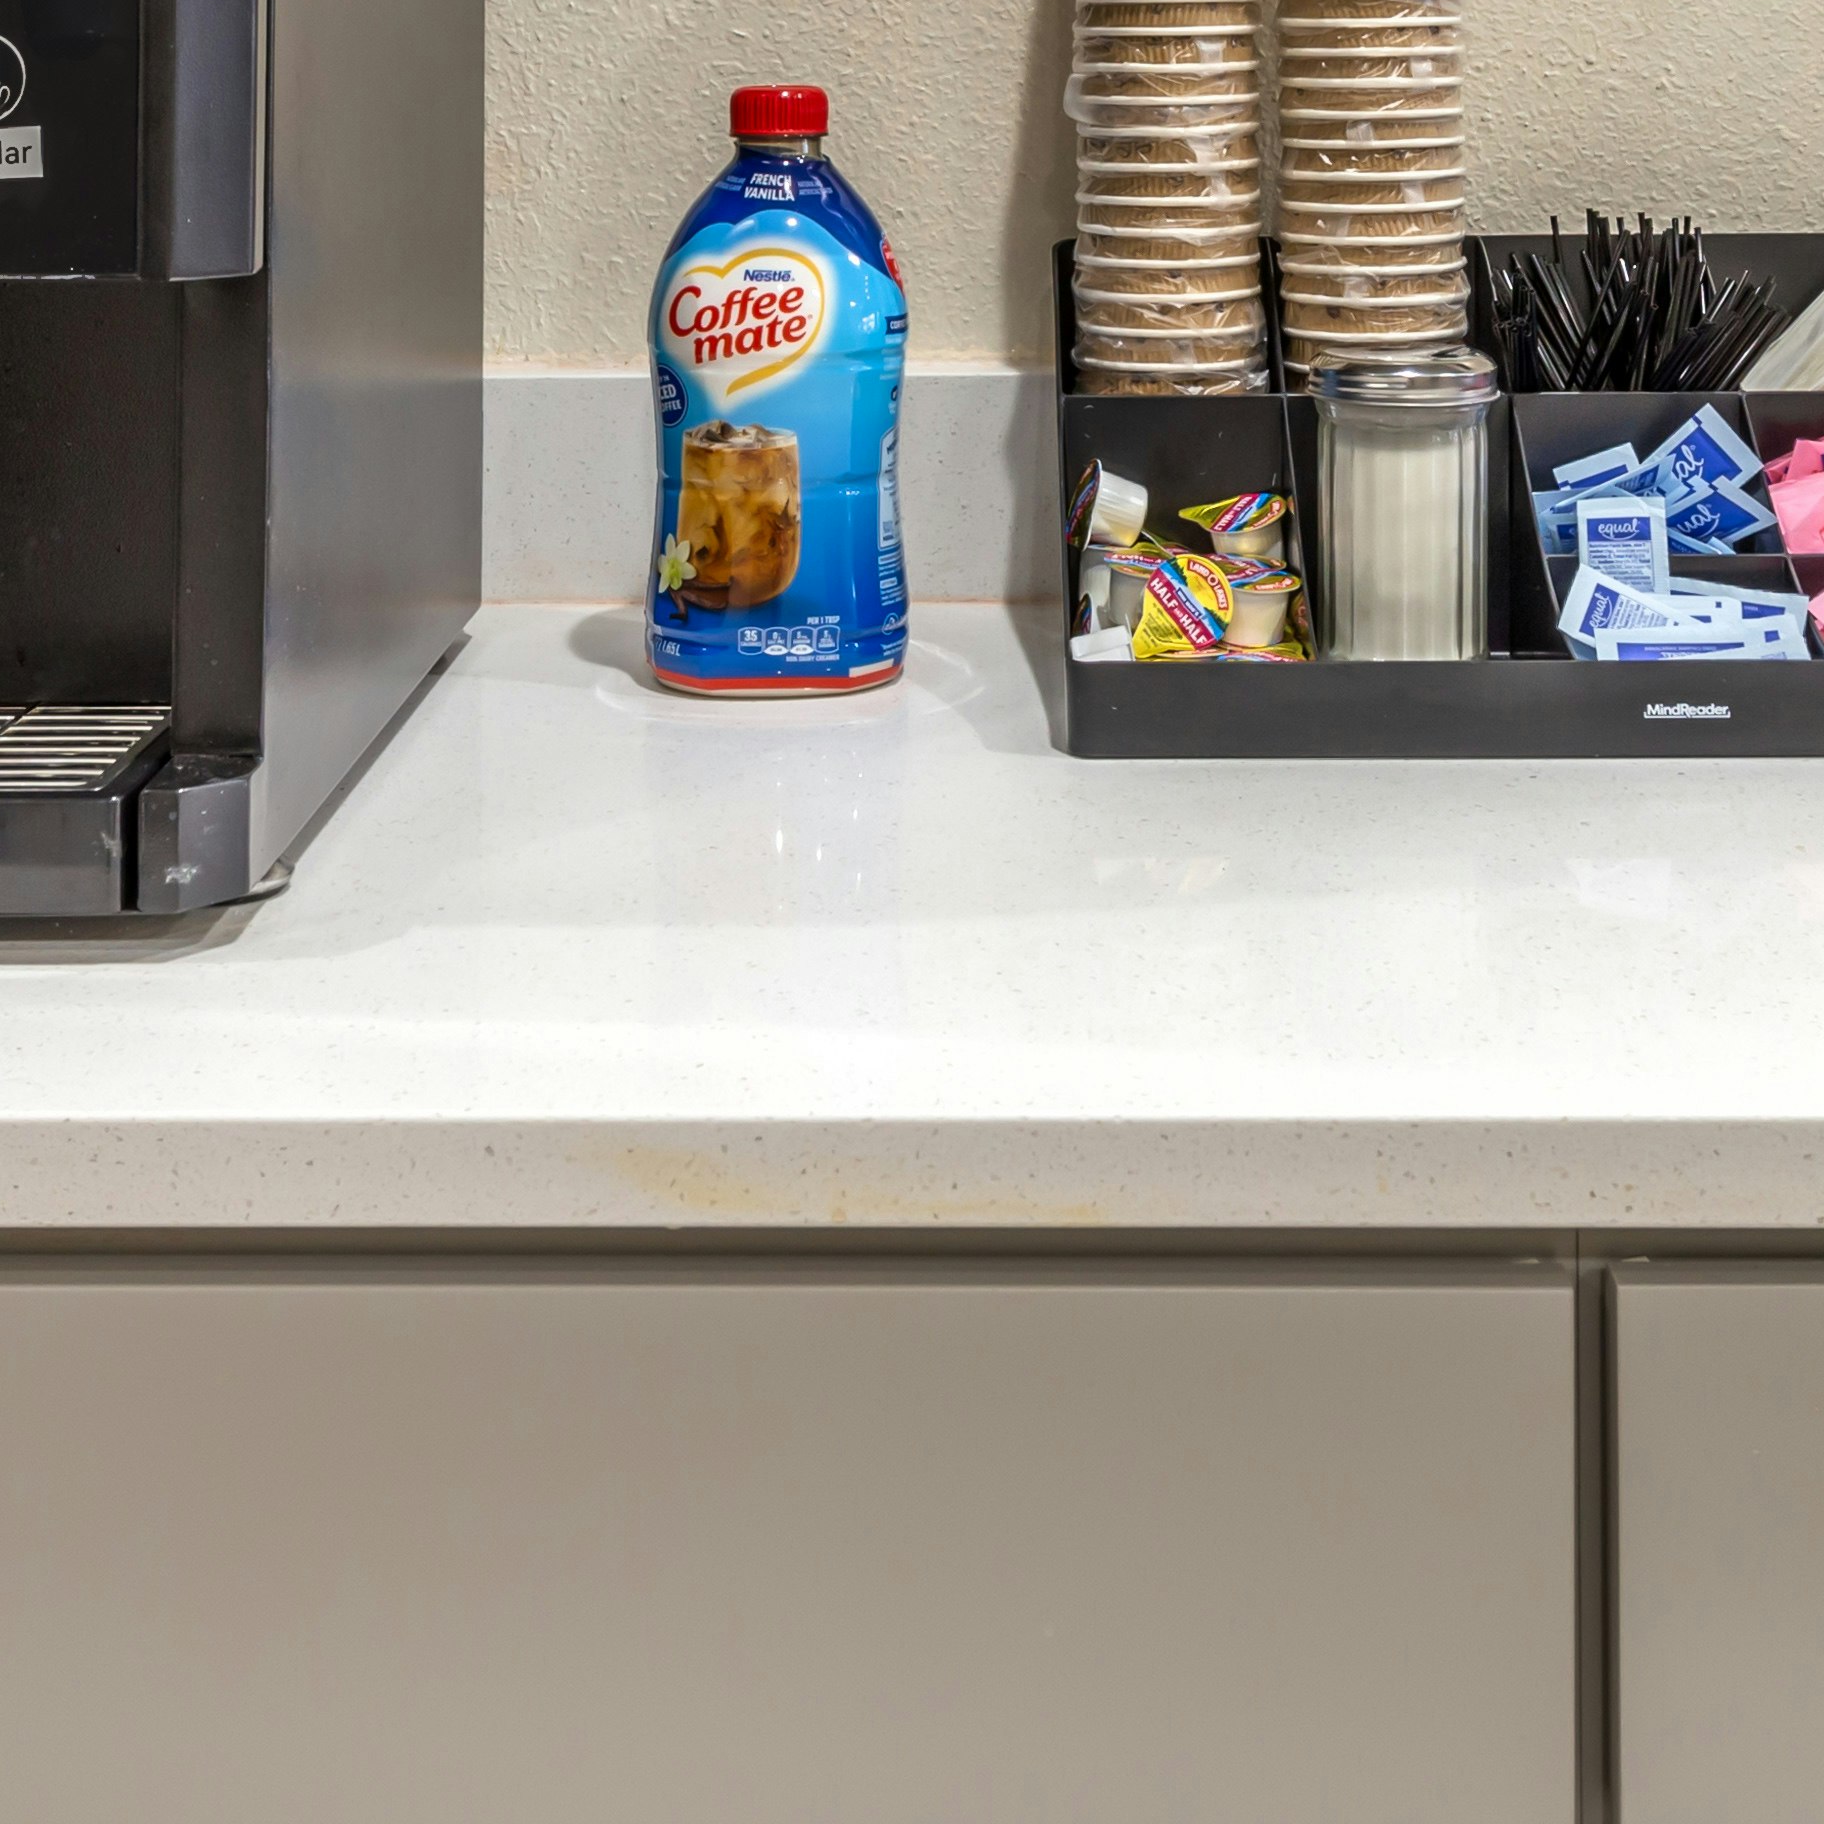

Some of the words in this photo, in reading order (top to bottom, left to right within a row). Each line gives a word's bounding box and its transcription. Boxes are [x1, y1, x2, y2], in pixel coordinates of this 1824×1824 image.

[749, 173, 792, 187] FRENCH
[743, 186, 796, 202] VANILLA
[668, 285, 805, 338] Coffee
[693, 315, 807, 365] mate
[1598, 518, 1640, 540] equal
[1150, 577, 1179, 609] HALF
[1179, 614, 1208, 644] HALF
[1588, 591, 1612, 628] equal
[743, 629, 758, 642] 35
[1646, 702, 1730, 718] MindReader
